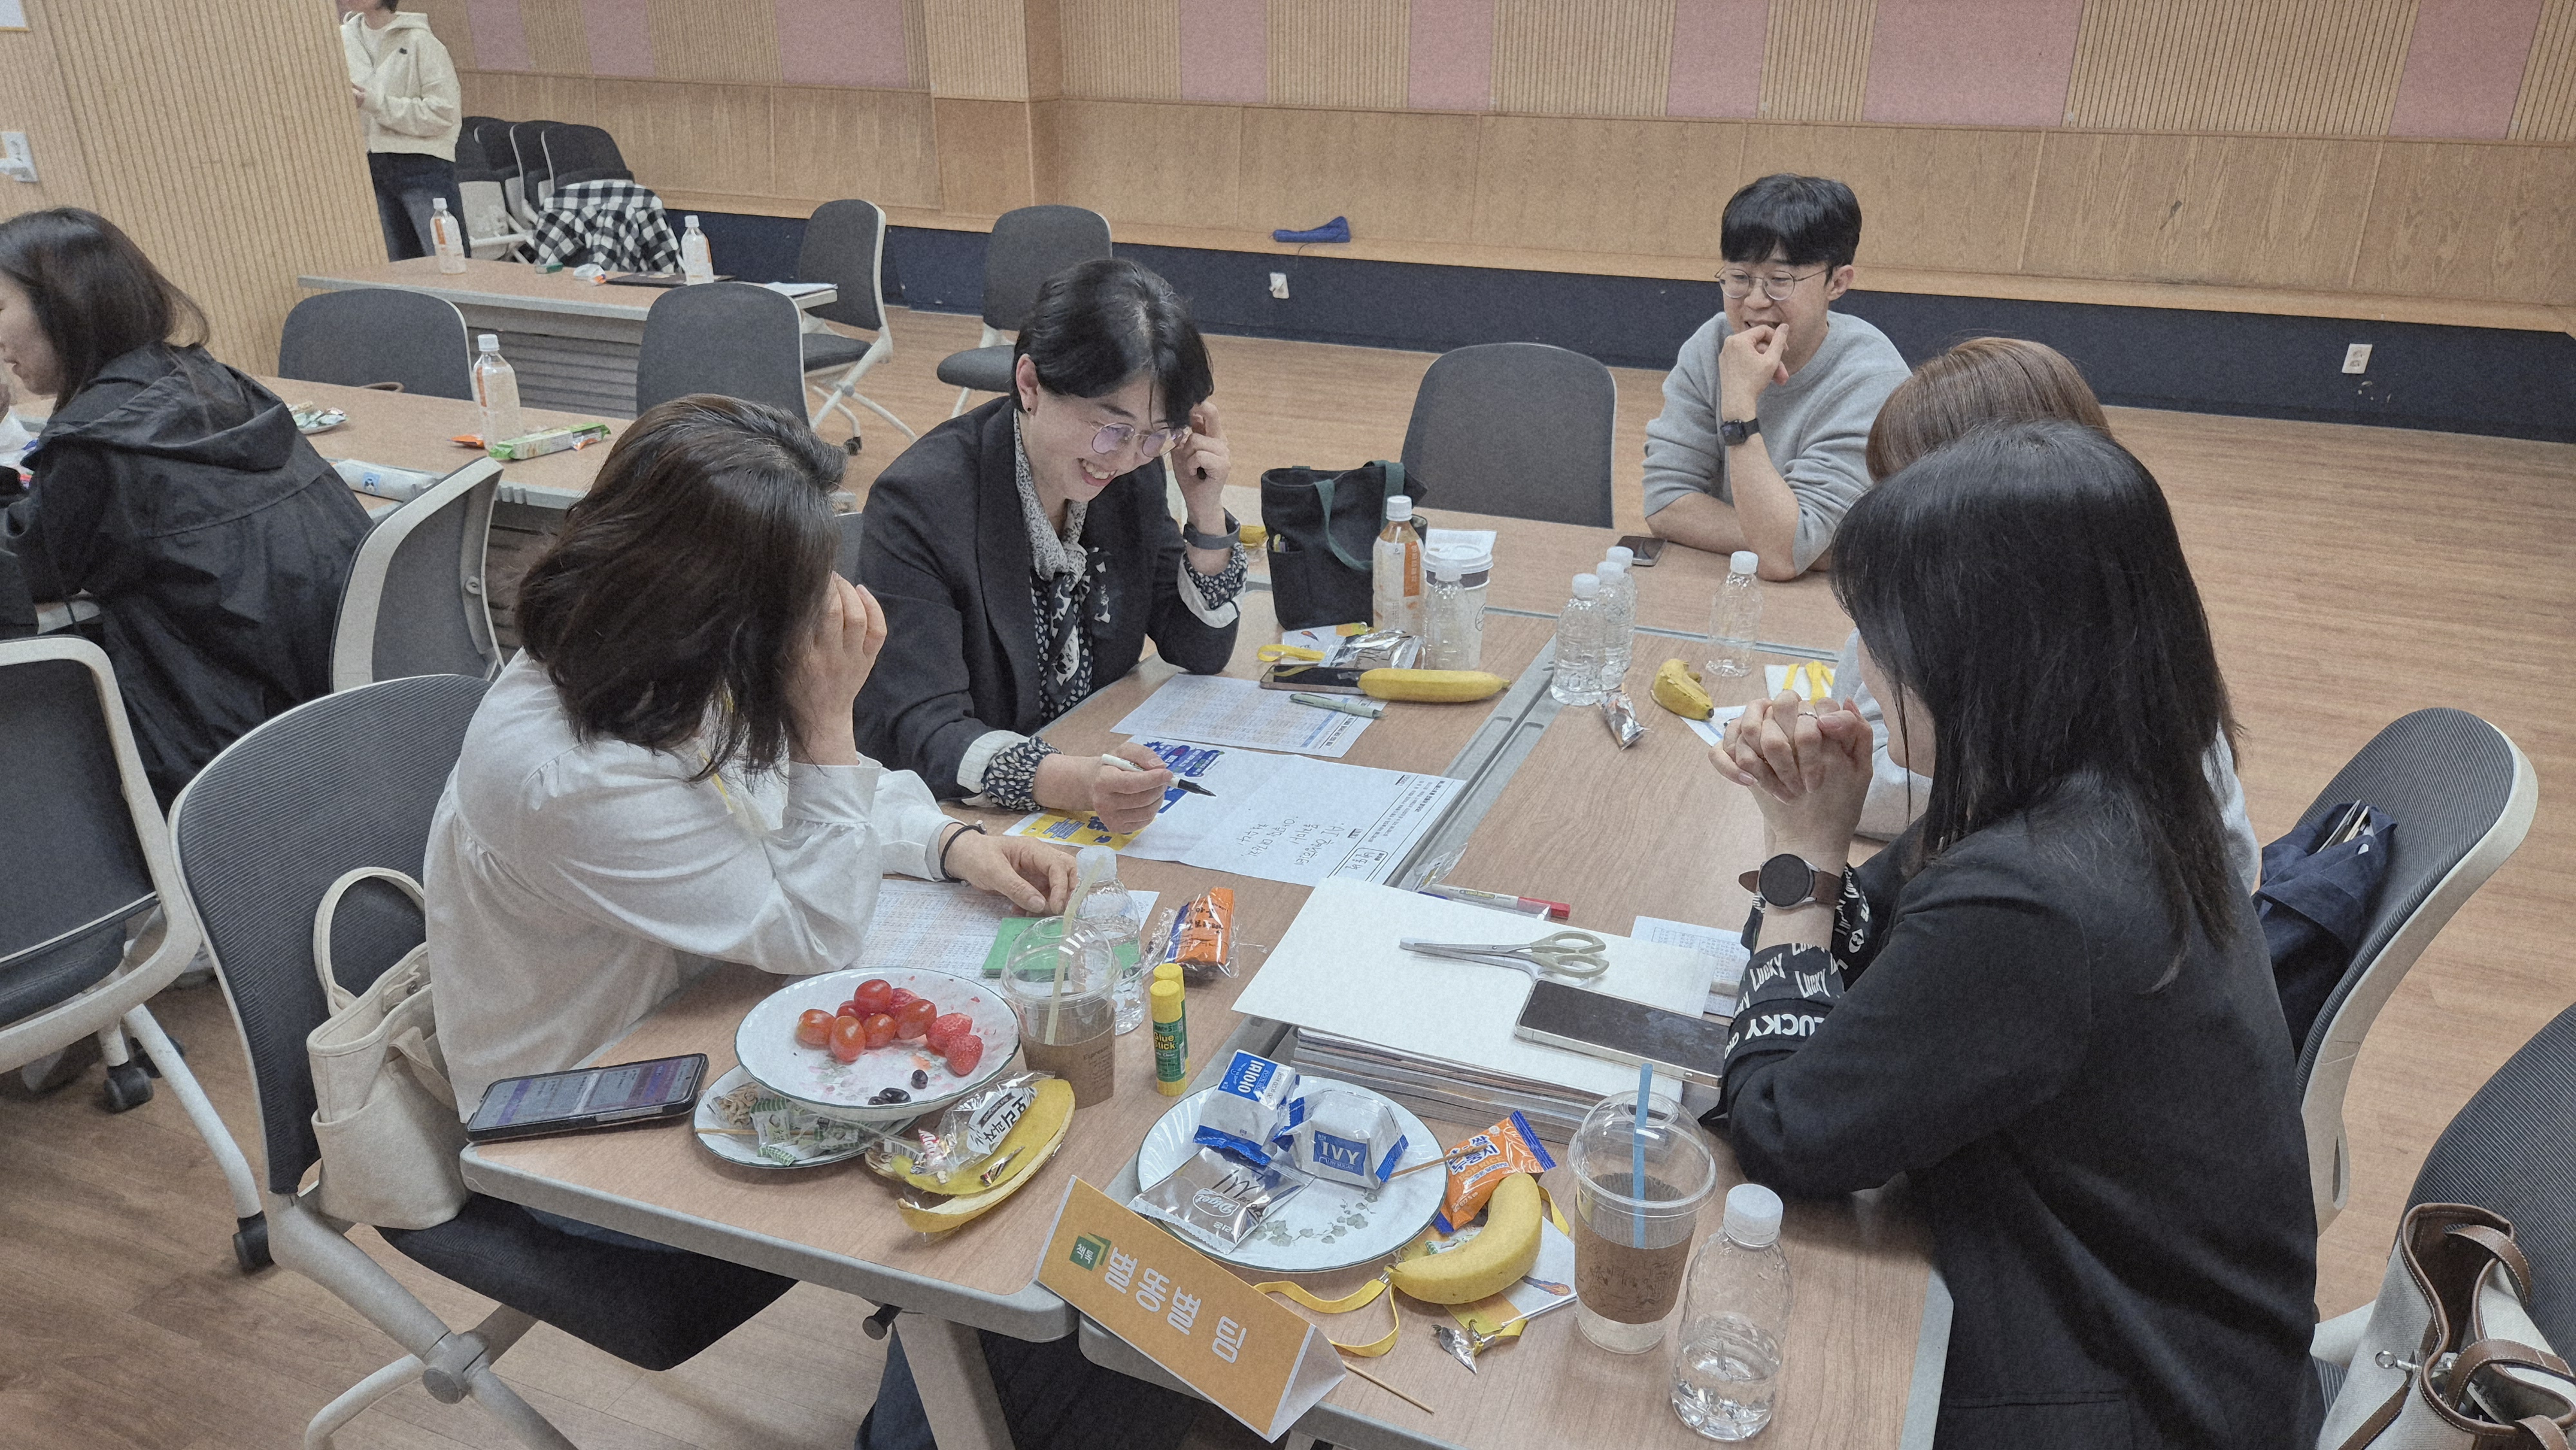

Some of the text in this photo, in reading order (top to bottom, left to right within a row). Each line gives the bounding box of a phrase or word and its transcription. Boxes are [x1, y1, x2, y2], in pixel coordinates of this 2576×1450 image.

[1321, 825, 1345, 837] AI
[1345, 852, 1376, 870] 별똥별
[1749, 953, 1786, 992] LUCKY
[1795, 968, 1831, 999] LUCKY
[1153, 1031, 1175, 1042] Glue
[1154, 1040, 1176, 1050] Stick
[1237, 1059, 1265, 1093] 아이비
[1322, 1141, 1361, 1165] IVY
[1197, 1193, 1236, 1214] Diget
[1075, 1243, 1095, 1265] 책톡
[1104, 1247, 1247, 1364] 별똥별 팀
